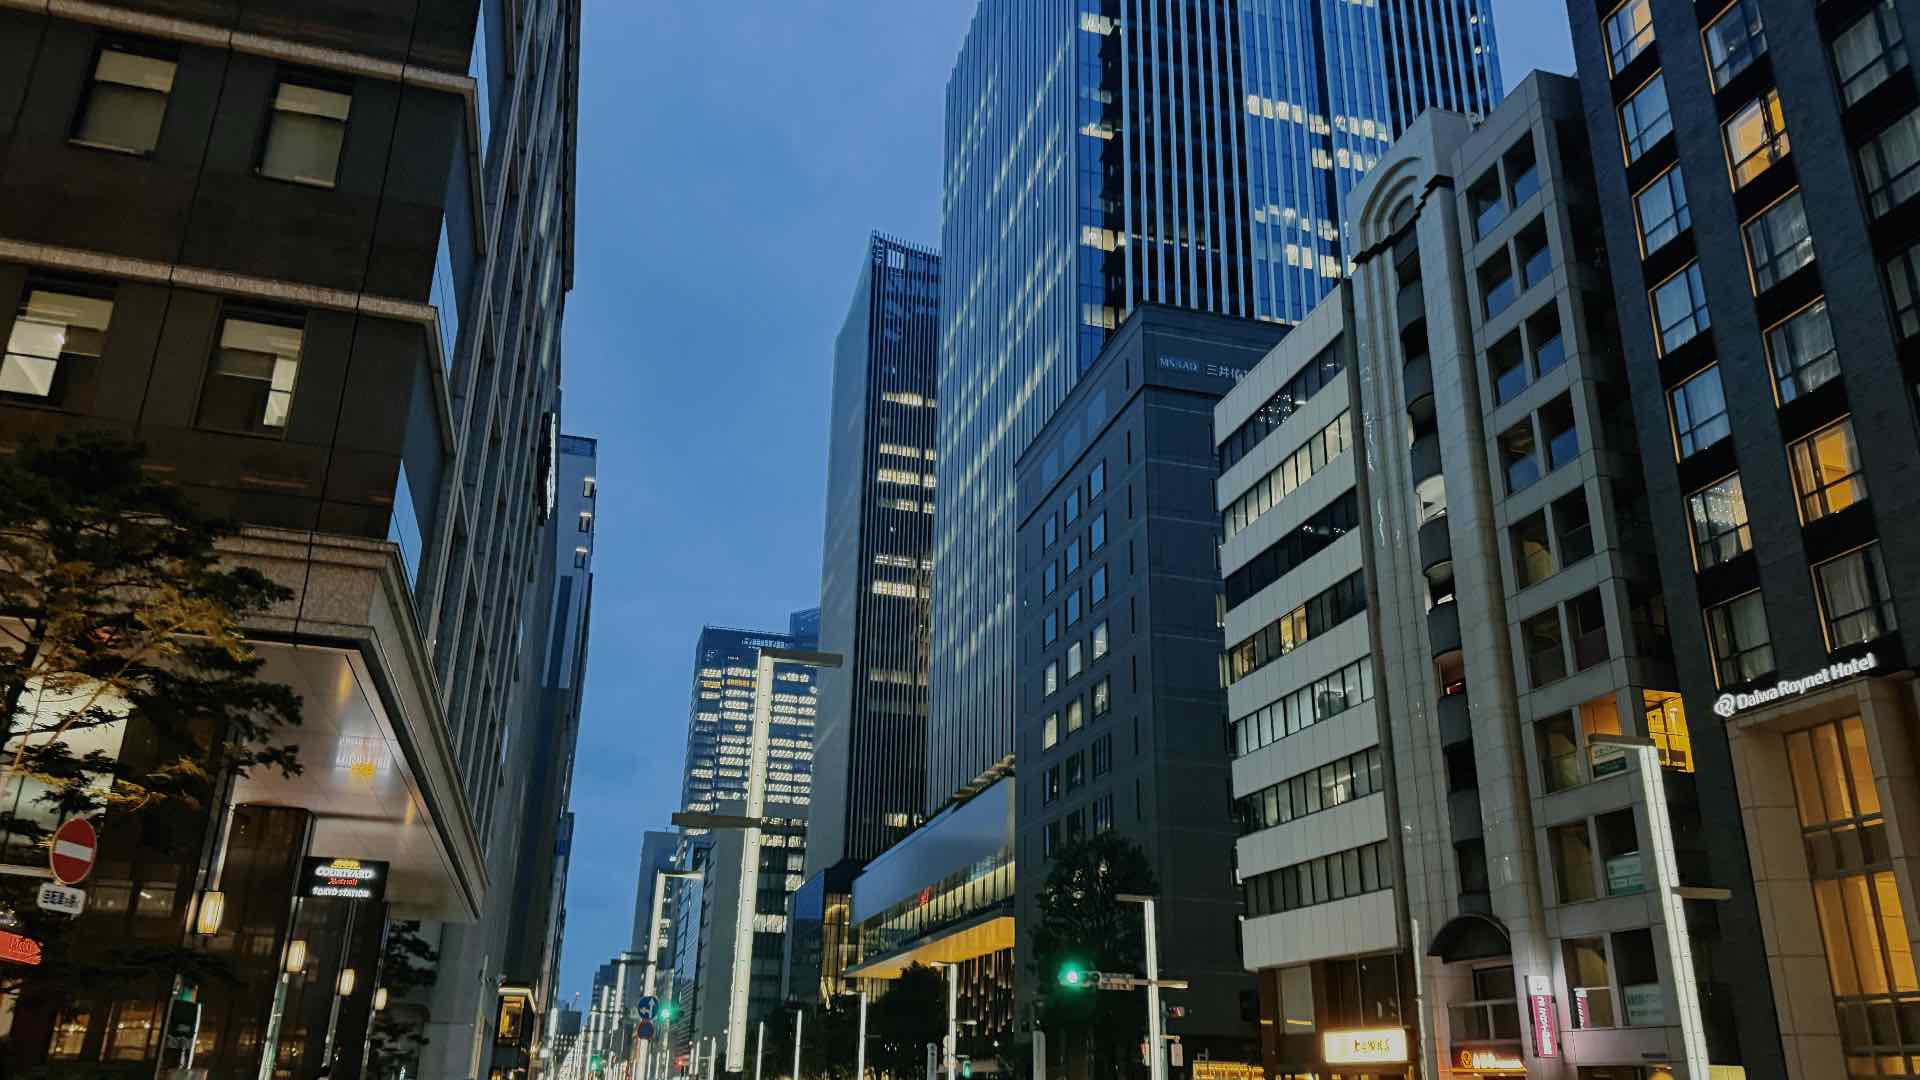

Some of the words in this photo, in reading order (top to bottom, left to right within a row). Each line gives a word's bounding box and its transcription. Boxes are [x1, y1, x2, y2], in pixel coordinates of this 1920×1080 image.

[1736, 686, 1778, 710] Daiwa
[1778, 669, 1830, 694] Roynet
[1830, 652, 1876, 679] Hotel
[339, 888, 371, 898] STATION
